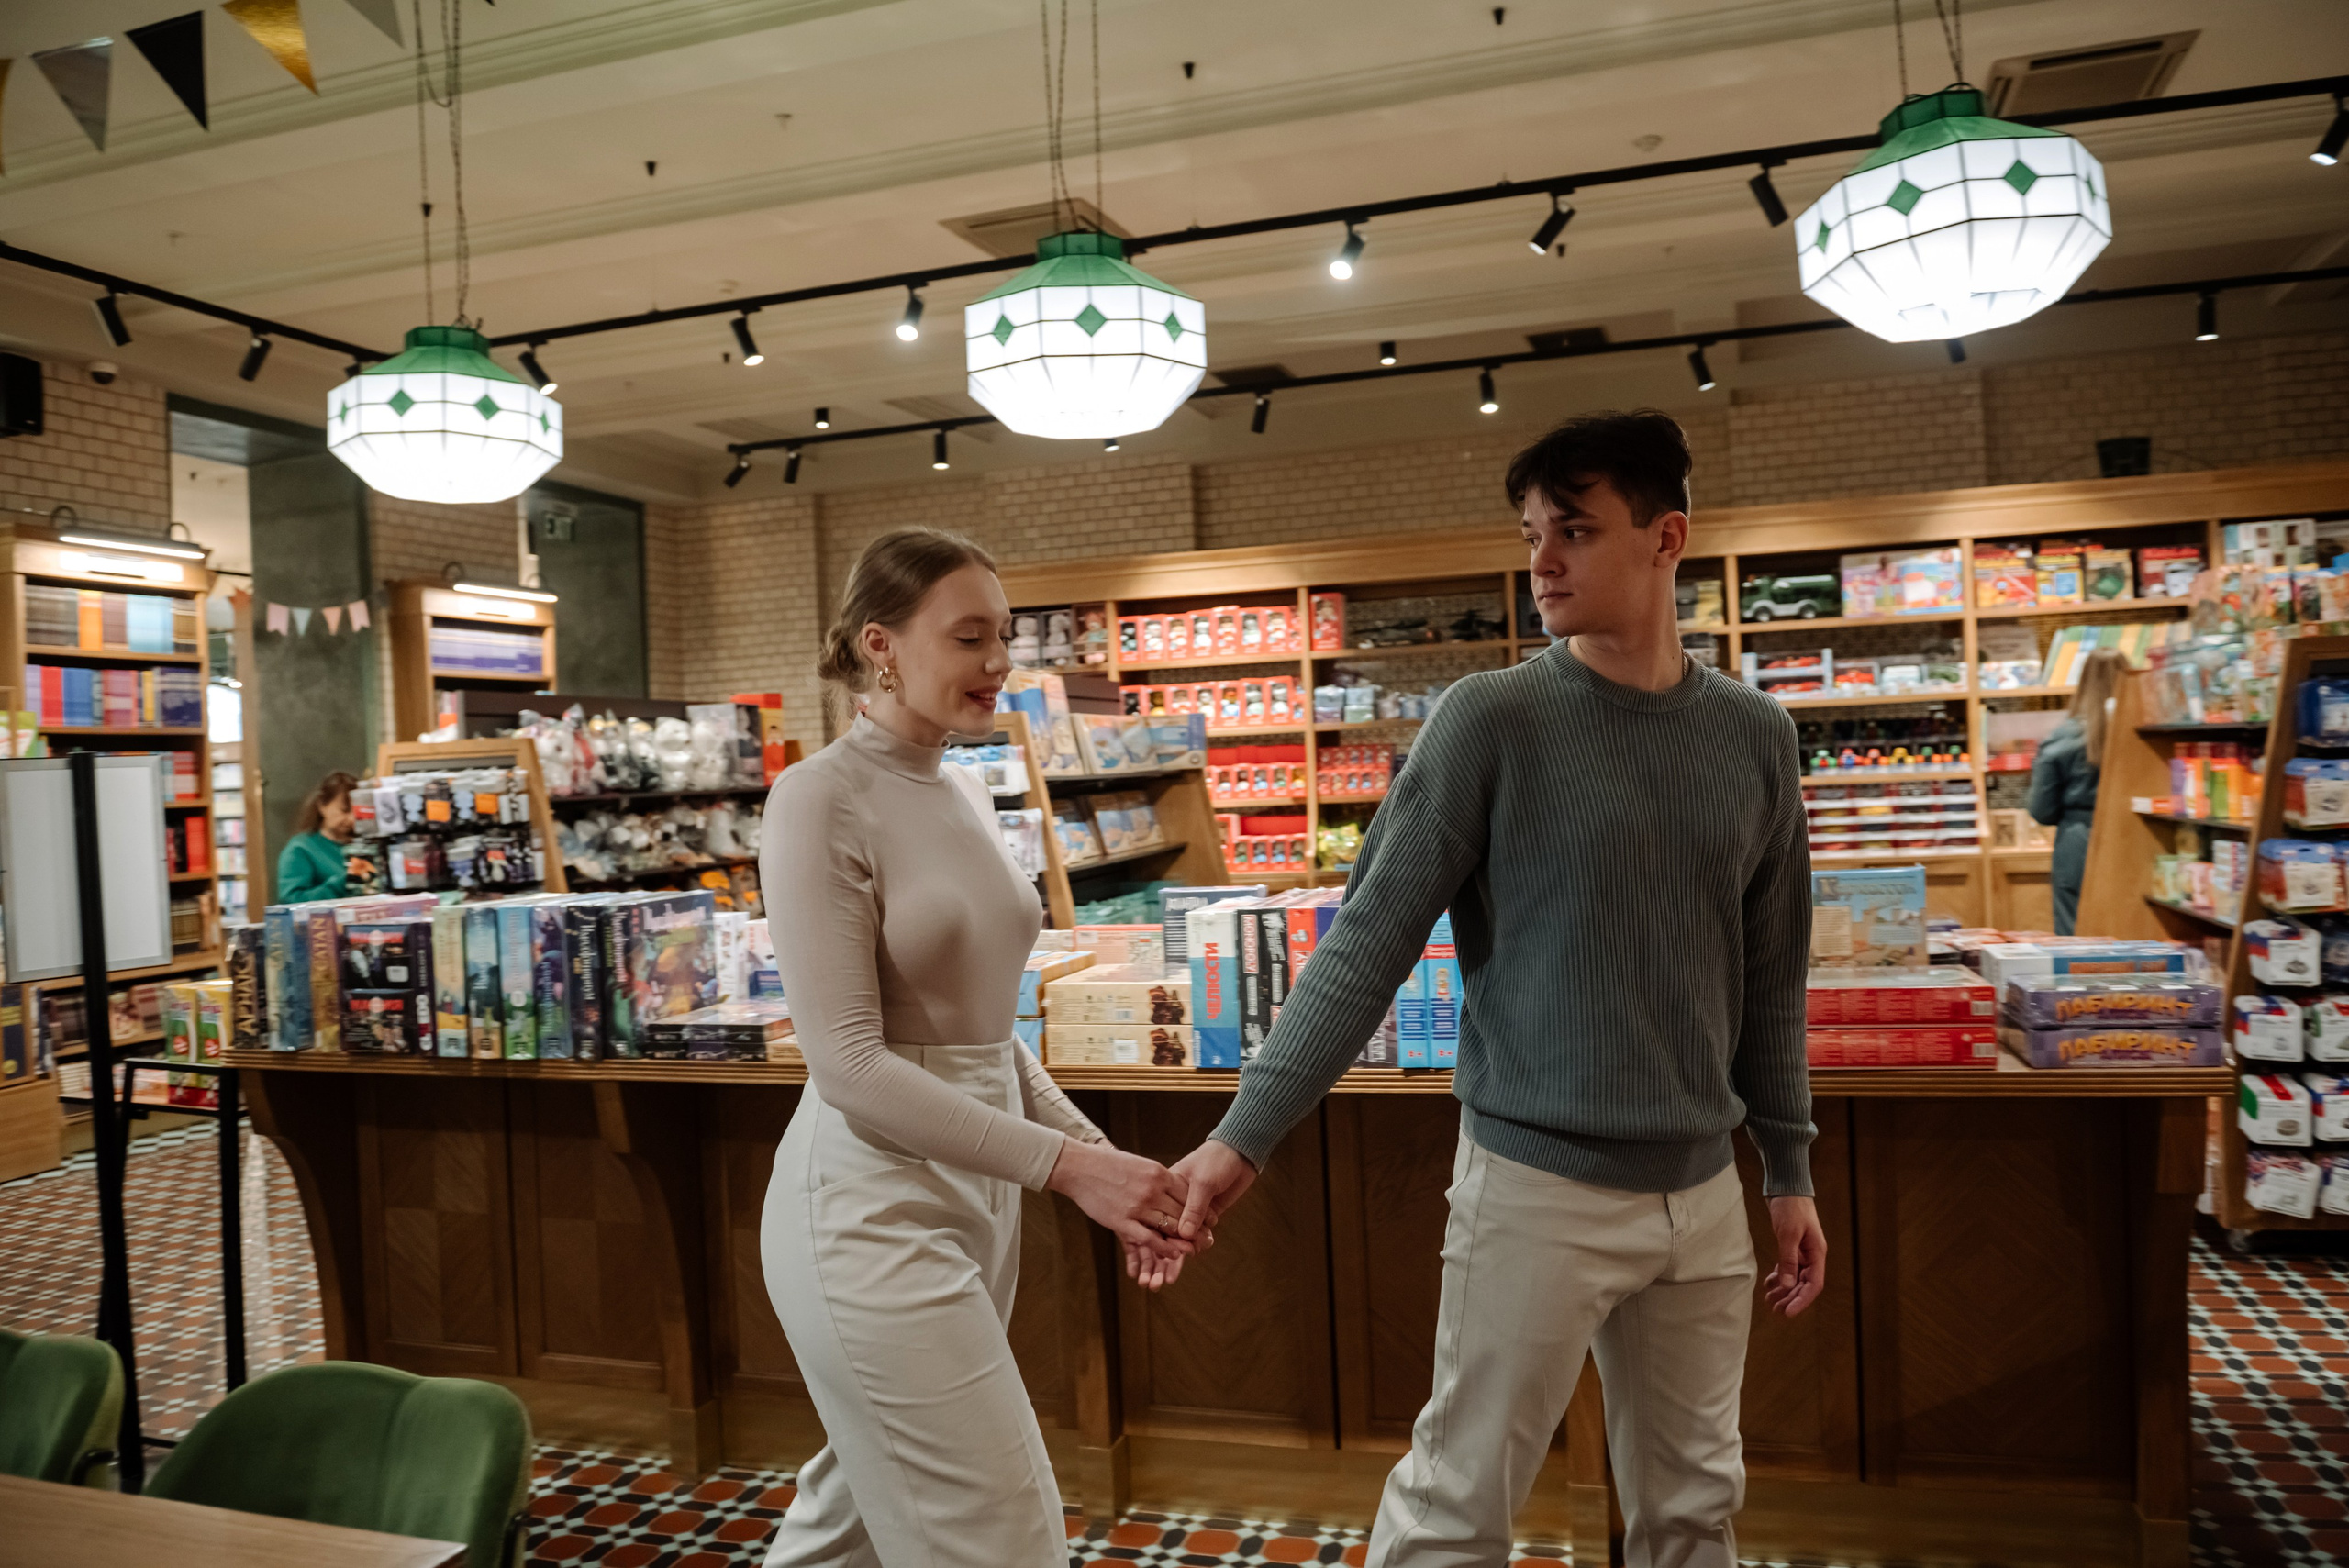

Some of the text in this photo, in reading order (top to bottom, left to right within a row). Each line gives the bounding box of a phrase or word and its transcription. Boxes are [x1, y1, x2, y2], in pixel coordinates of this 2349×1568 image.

[313, 918, 326, 971] CATAN
[1242, 915, 1256, 973] MONOPOLY
[1204, 942, 1222, 1019] ЧЕЛЮСТИ
[416, 994, 433, 1051] CLUEDO
